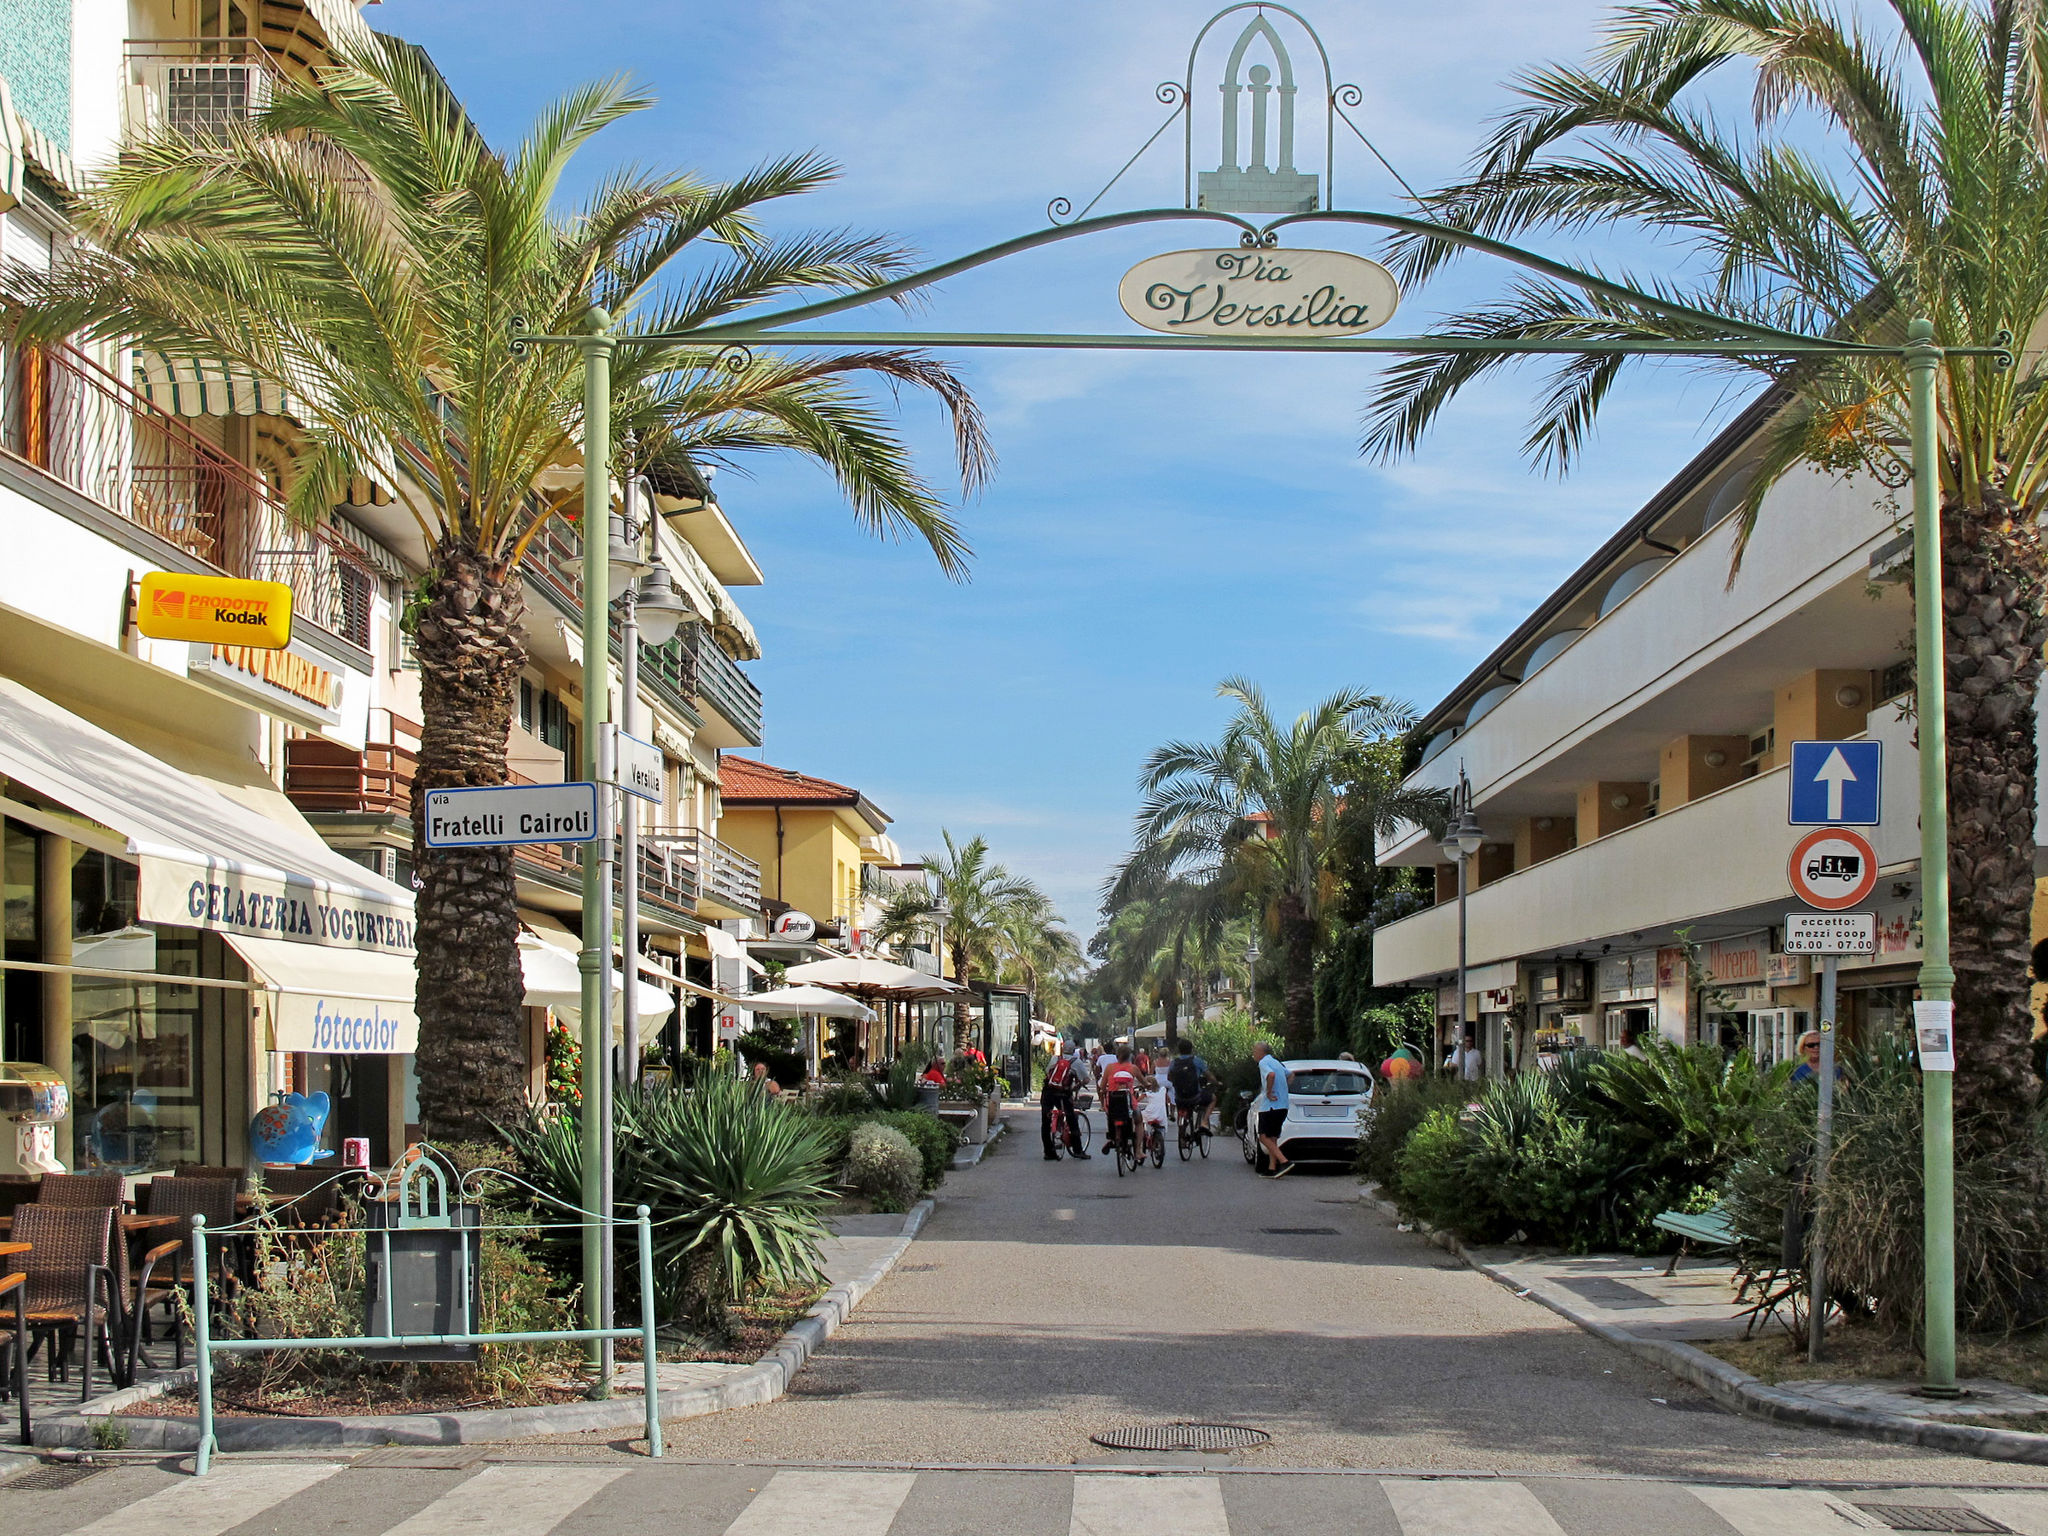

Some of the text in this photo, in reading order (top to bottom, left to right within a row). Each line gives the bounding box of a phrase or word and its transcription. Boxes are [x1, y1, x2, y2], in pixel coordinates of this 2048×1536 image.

[1215, 253, 1292, 281] Via
[1145, 283, 1369, 326] Versilia
[188, 594, 269, 612] PRODOTTI
[214, 608, 268, 626] Kodak
[631, 763, 660, 792] Versilia
[432, 795, 449, 804] via
[432, 810, 589, 837] Fratelli Cairoli
[1825, 858, 1833, 872] 5
[188, 880, 414, 949] GELATERIA YOGURTERI
[1801, 918, 1856, 926] eccetto:
[1788, 941, 1822, 949] 06.00
[1837, 941, 1873, 949] 07.00
[1794, 929, 1866, 939] mezzi coop
[1711, 935, 1760, 980] libreria
[312, 1000, 399, 1050] fotocolor
